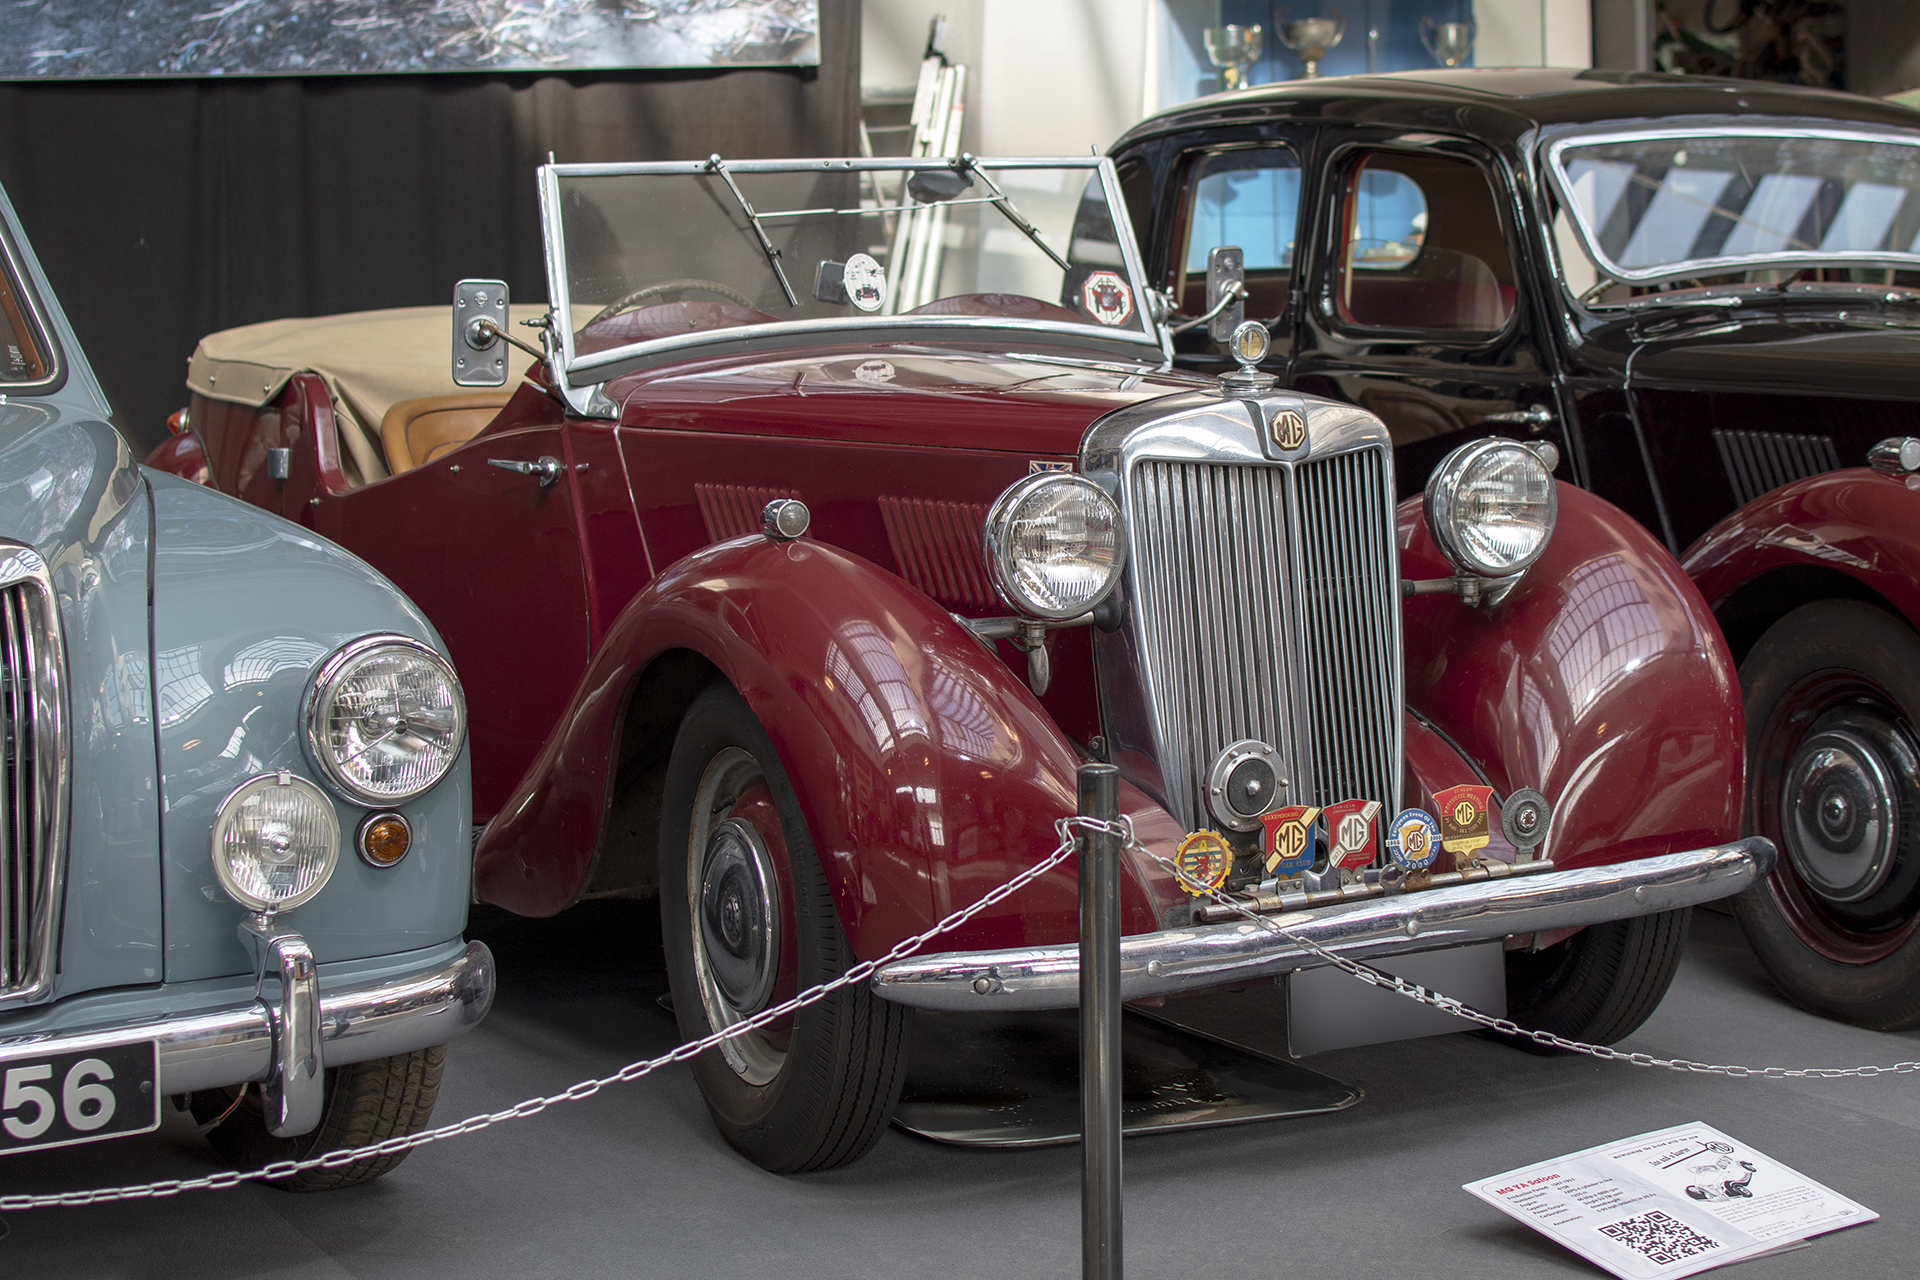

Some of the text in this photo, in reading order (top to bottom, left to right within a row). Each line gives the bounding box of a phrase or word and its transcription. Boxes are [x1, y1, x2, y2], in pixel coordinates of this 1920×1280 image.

[1275, 414, 1302, 445] MG
[1466, 793, 1484, 810] MEETING
[1264, 811, 1299, 820] LUXEMBOURG
[1456, 803, 1473, 824] MG
[1341, 818, 1364, 848] MG
[1392, 814, 1410, 837] European
[1198, 840, 1210, 852] A
[1278, 824, 1304, 854] MG
[1408, 832, 1423, 850] MG
[1406, 860, 1428, 870] 2000
[2, 1058, 116, 1139] 56
[1527, 1174, 1560, 1185] Saloon
[1507, 1191, 1533, 1200] Production
